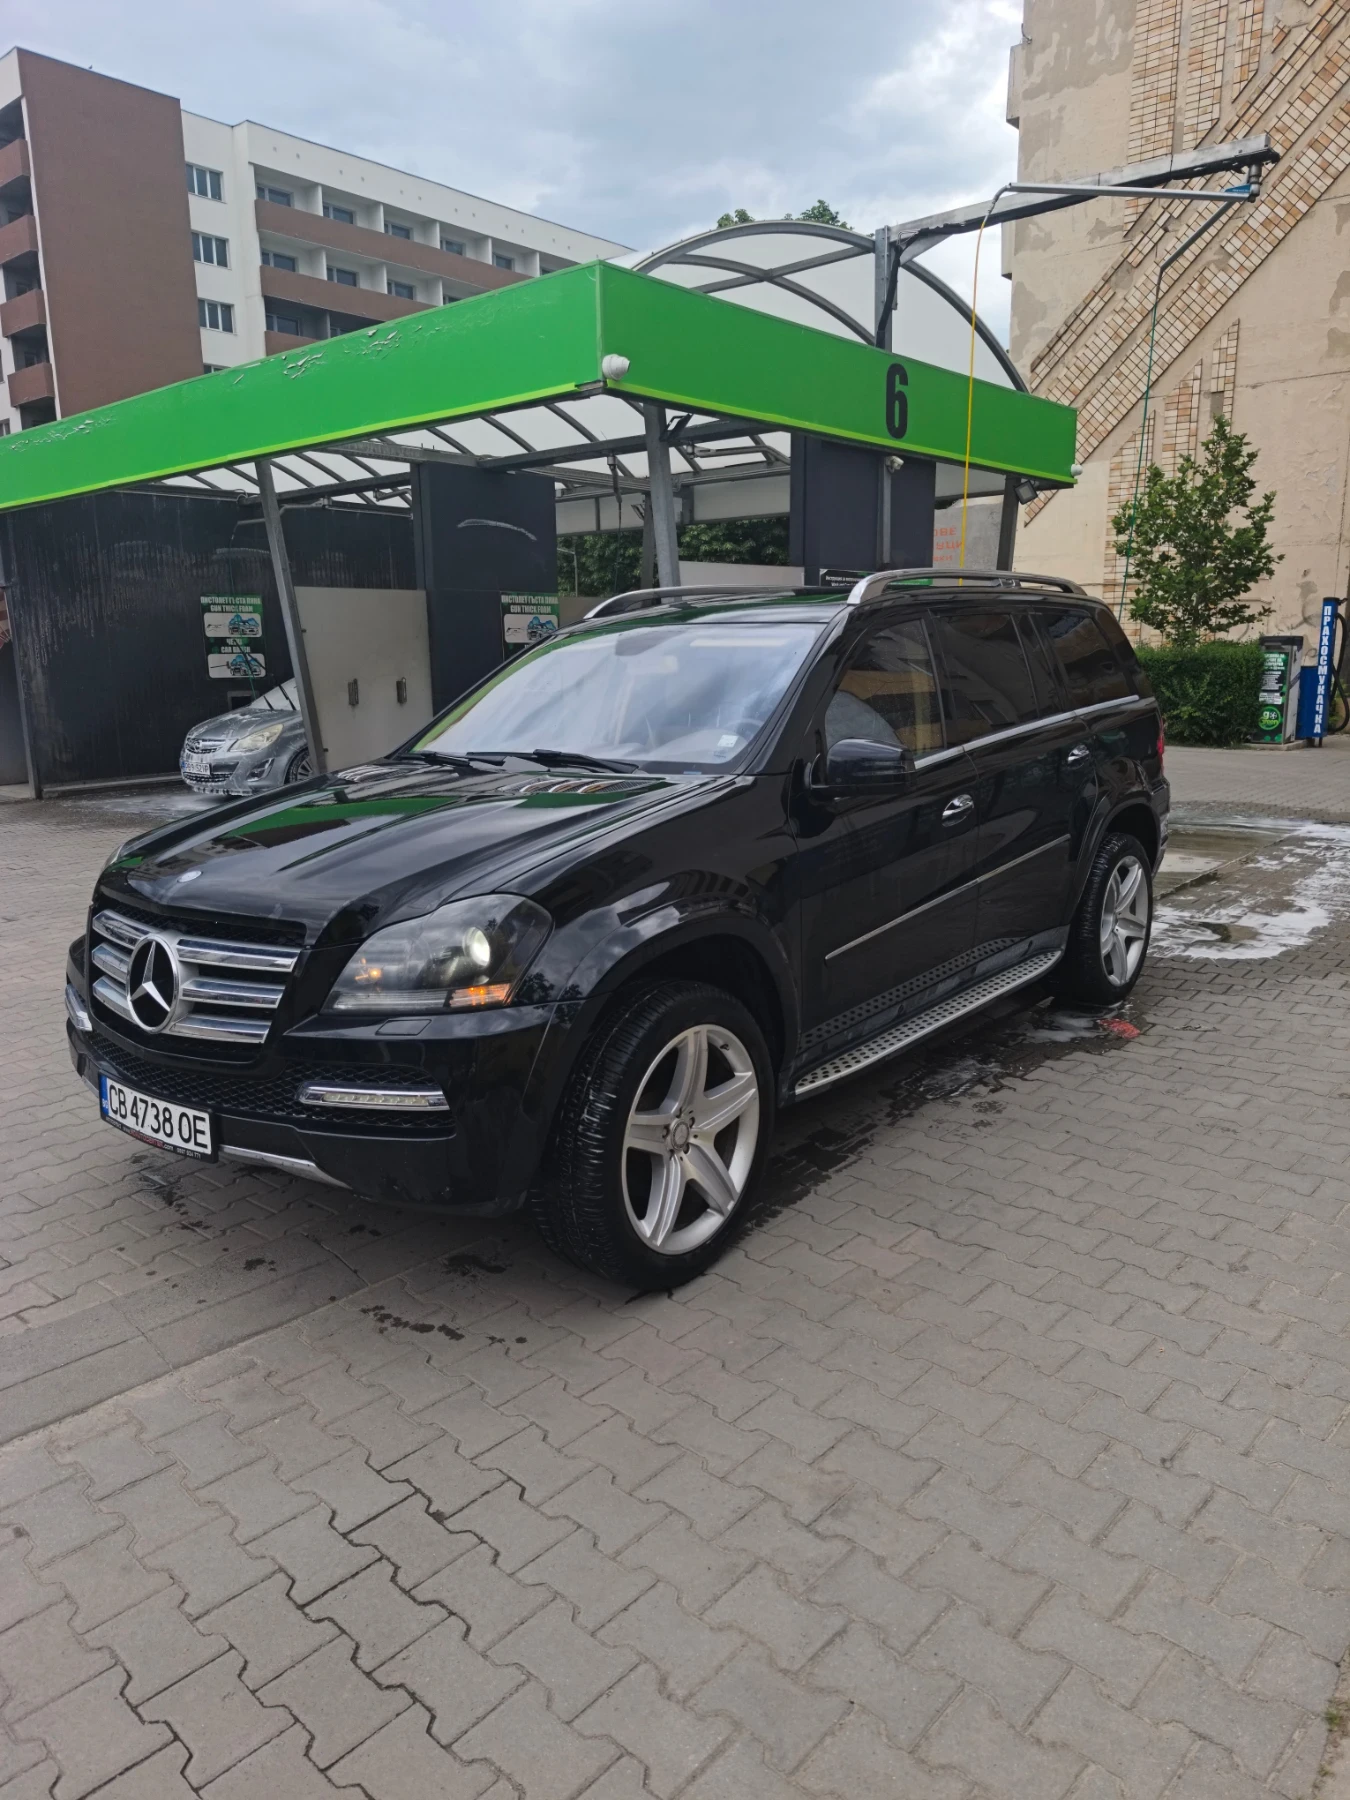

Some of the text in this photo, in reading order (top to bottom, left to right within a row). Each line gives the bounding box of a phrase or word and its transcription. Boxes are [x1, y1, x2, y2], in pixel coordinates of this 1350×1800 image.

[886, 362, 909, 440] 6
[239, 605, 254, 613] FOAM
[510, 605, 551, 614] GUN THICK FOAM
[1313, 605, 1332, 734] ПРАХОСМУКАЧКА
[130, 1095, 174, 1138] 4738
